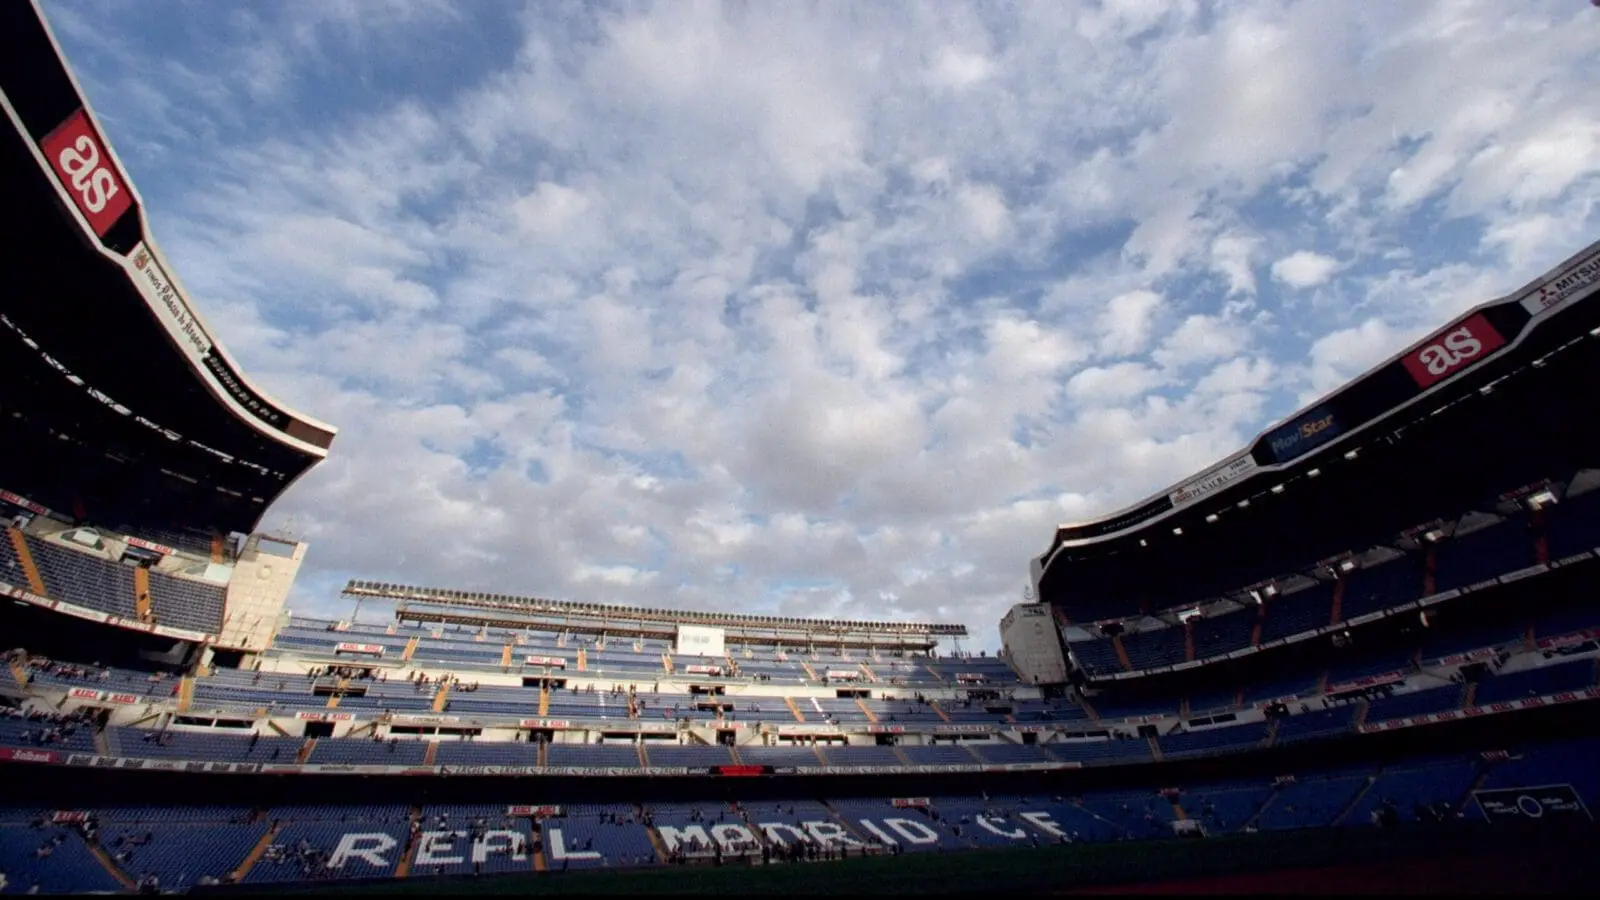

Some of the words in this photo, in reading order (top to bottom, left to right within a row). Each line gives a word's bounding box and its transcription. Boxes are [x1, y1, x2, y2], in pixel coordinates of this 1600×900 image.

[60, 135, 119, 213] as
[1419, 327, 1481, 375] as
[326, 828, 601, 868] REAL
[658, 818, 938, 852] MADRID
[976, 812, 1072, 842] CF
